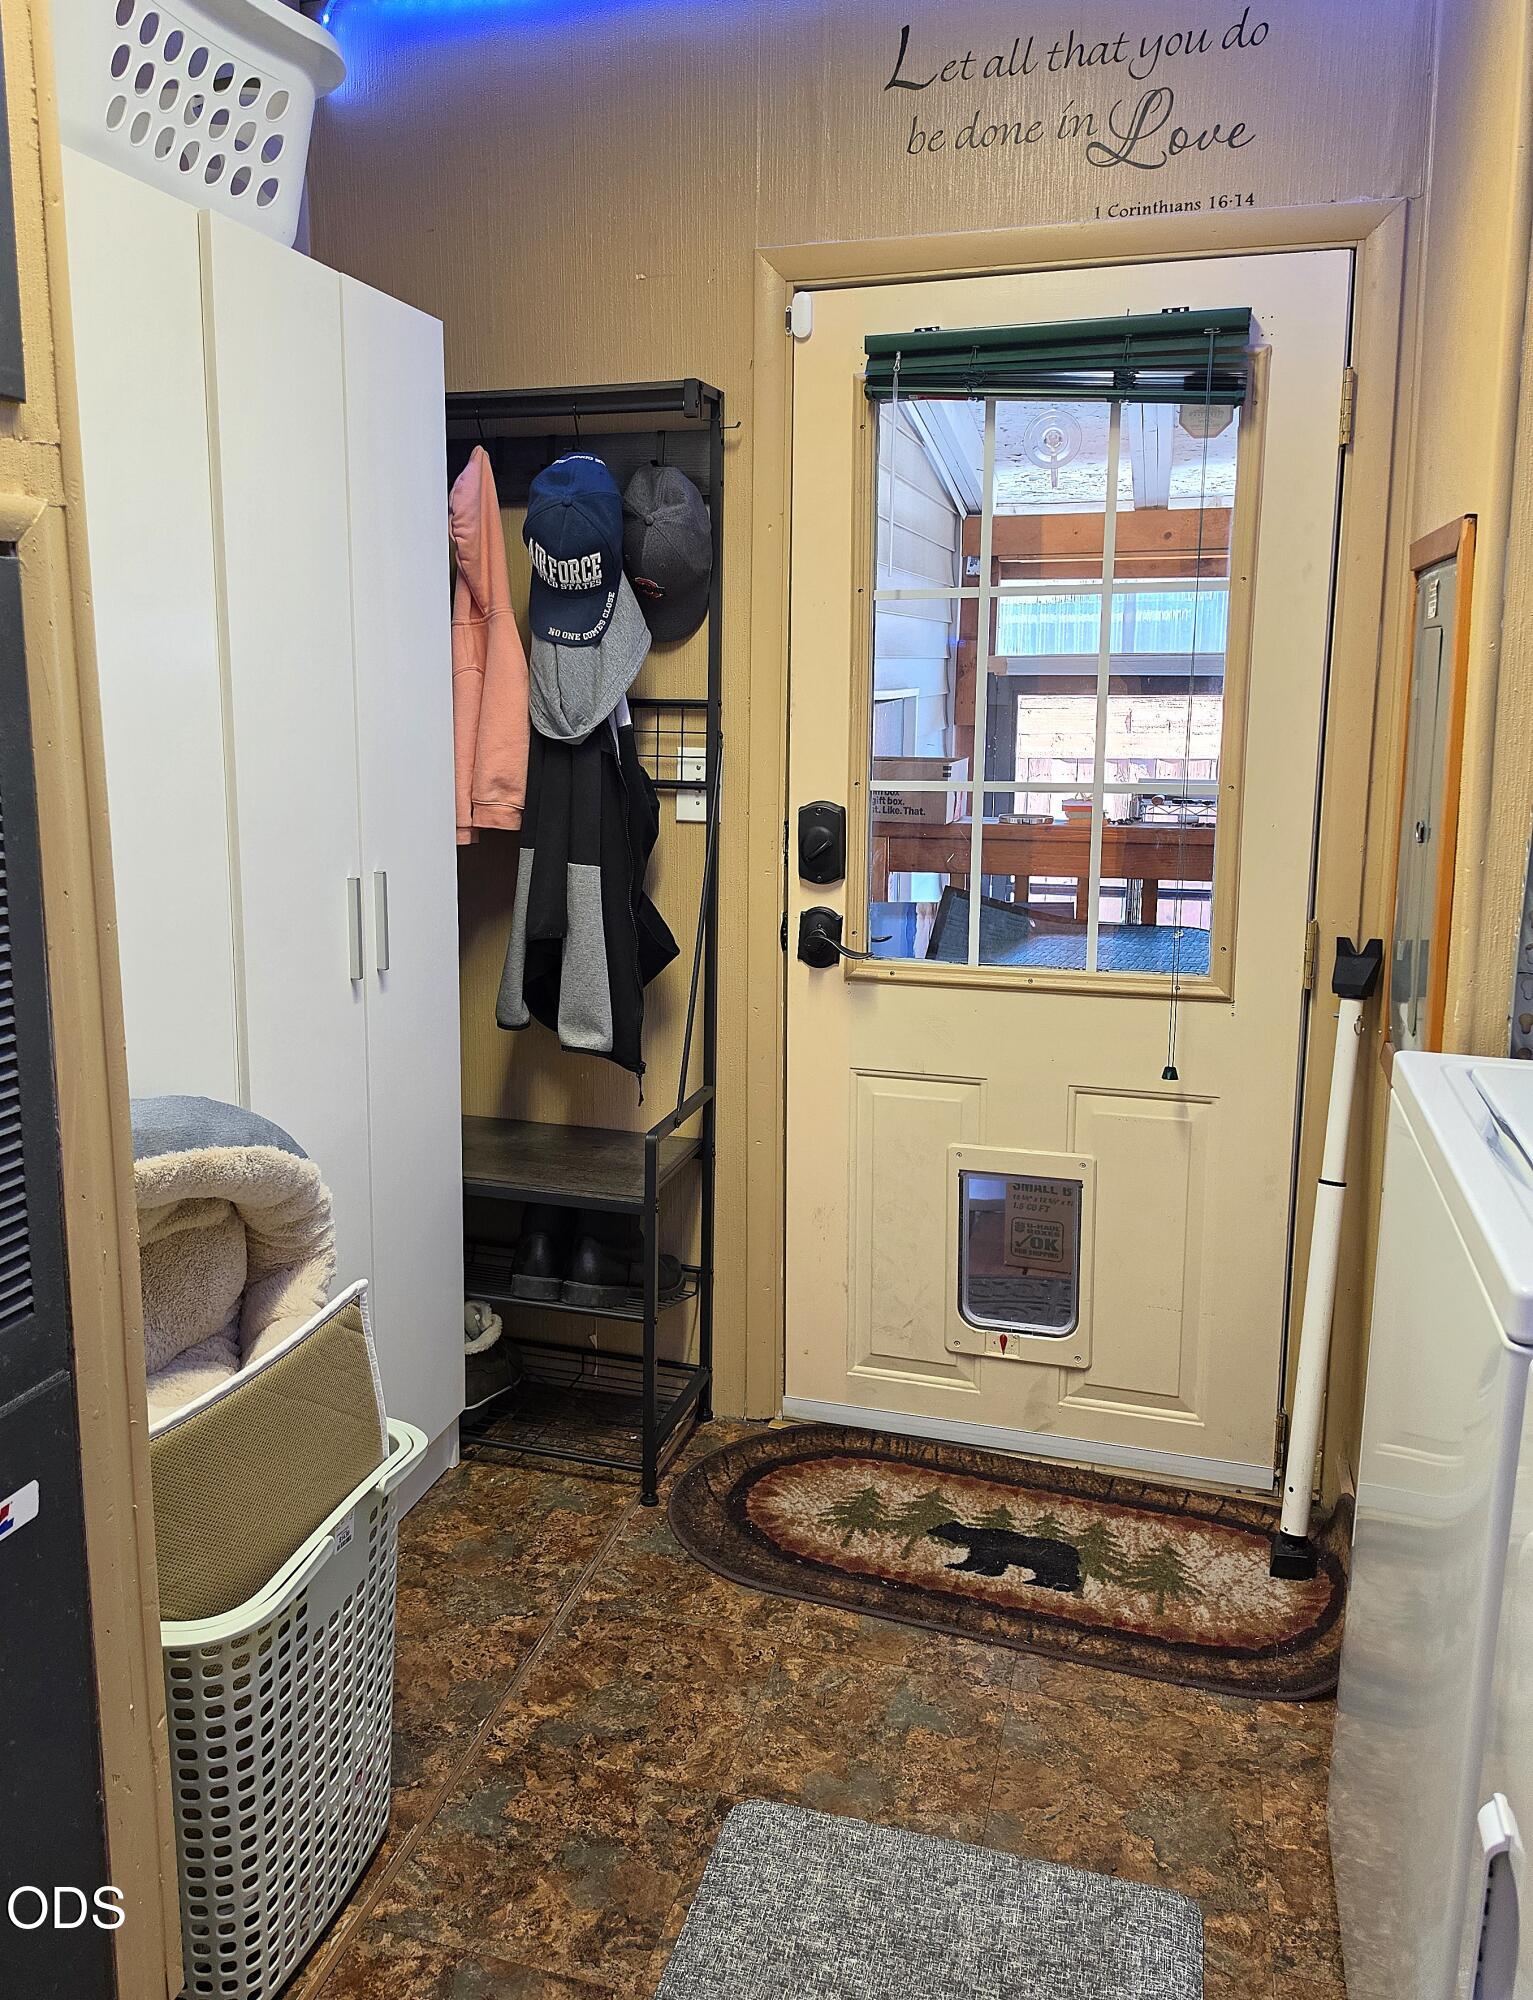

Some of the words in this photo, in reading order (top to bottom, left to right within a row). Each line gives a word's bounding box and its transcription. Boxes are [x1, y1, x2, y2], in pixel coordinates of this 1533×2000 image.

[884, 25, 976, 91] Let
[983, 36, 1039, 78] all
[1047, 30, 1130, 72] that
[1128, 27, 1212, 80] you
[1221, 6, 1270, 50] do
[906, 115, 946, 155] be
[954, 110, 1044, 150] done
[1057, 100, 1101, 140] in
[1086, 87, 1256, 169] Love
[1095, 206, 1101, 219] 1
[1108, 200, 1201, 218] Corinthians
[547, 551, 602, 584] FORCE
[560, 579, 602, 590] STATES
[548, 626, 561, 637] NO
[562, 631, 581, 640] ONE
[582, 619, 606, 640] COMES
[602, 591, 616, 618] CLOSE
[882, 806, 902, 815] Like.
[903, 806, 926, 815] That.
[887, 797, 905, 806] box.
[1030, 1236, 1059, 1252] OK
